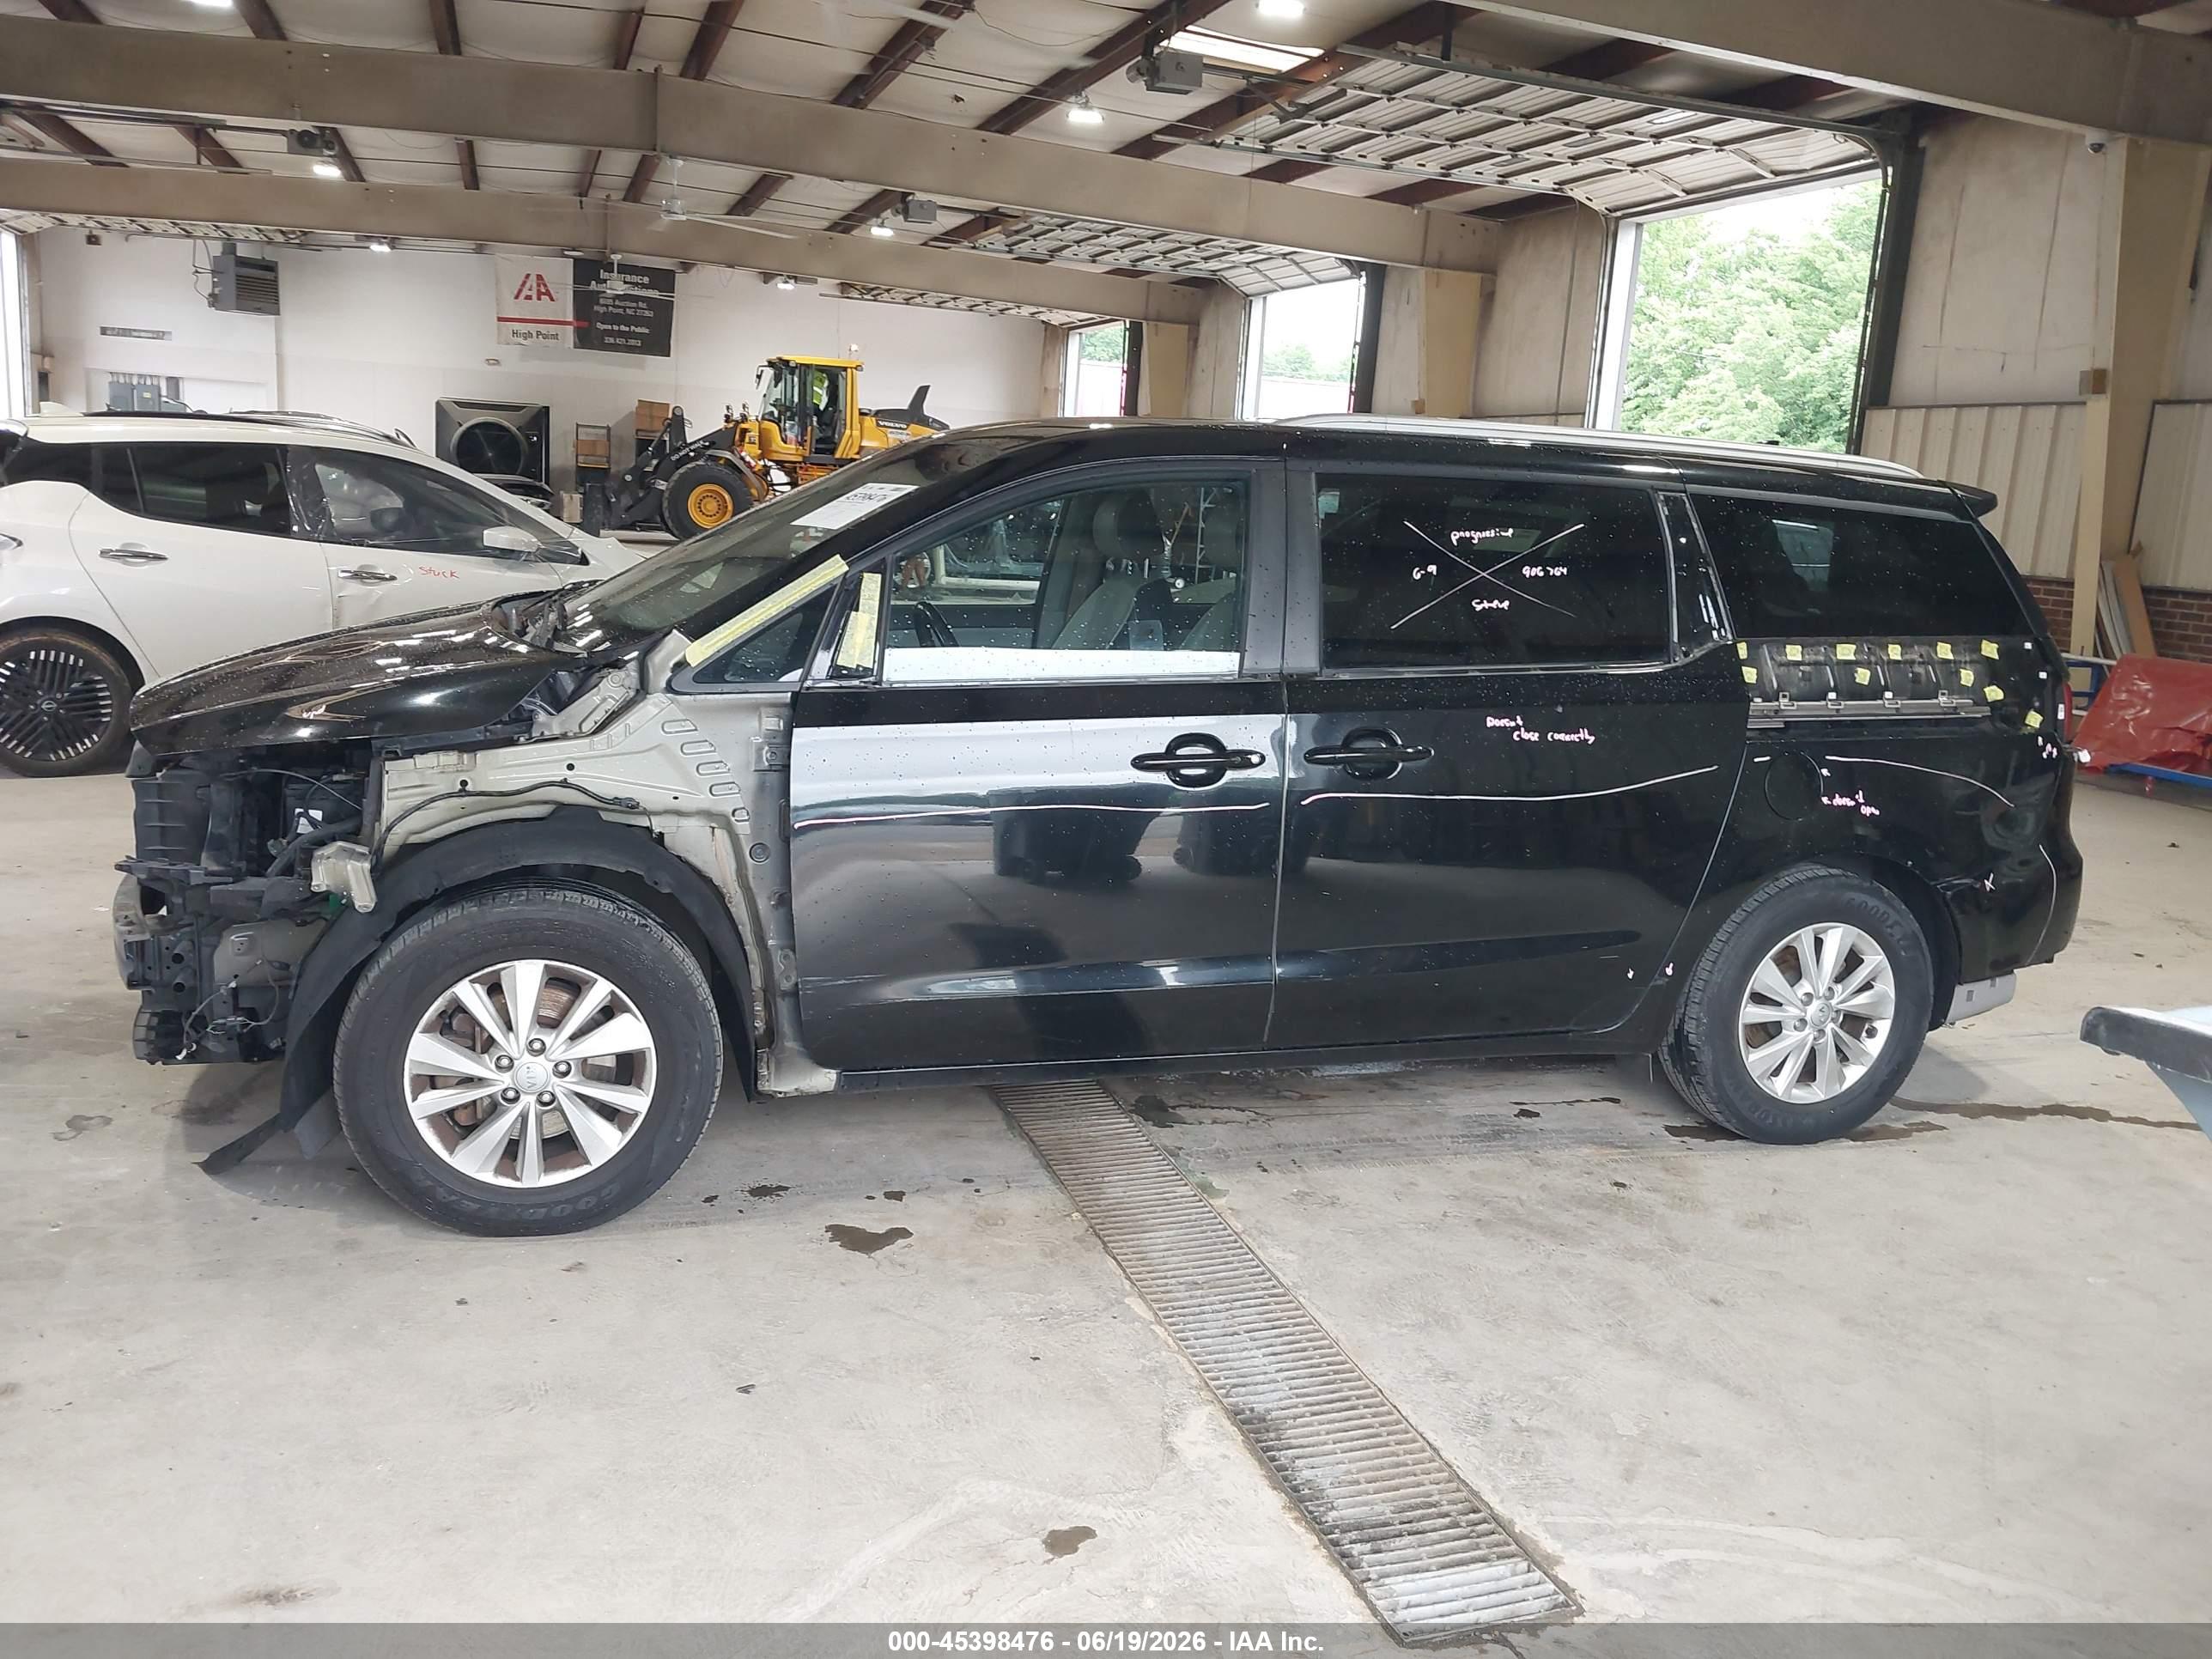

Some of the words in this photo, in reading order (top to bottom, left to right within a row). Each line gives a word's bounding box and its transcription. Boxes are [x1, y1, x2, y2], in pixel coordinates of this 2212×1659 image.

[600, 269, 650, 284] Insurance
[596, 322, 612, 331] Open
[512, 329, 533, 340] High
[536, 330, 560, 340] Point
[878, 420, 908, 428] VOLVO
